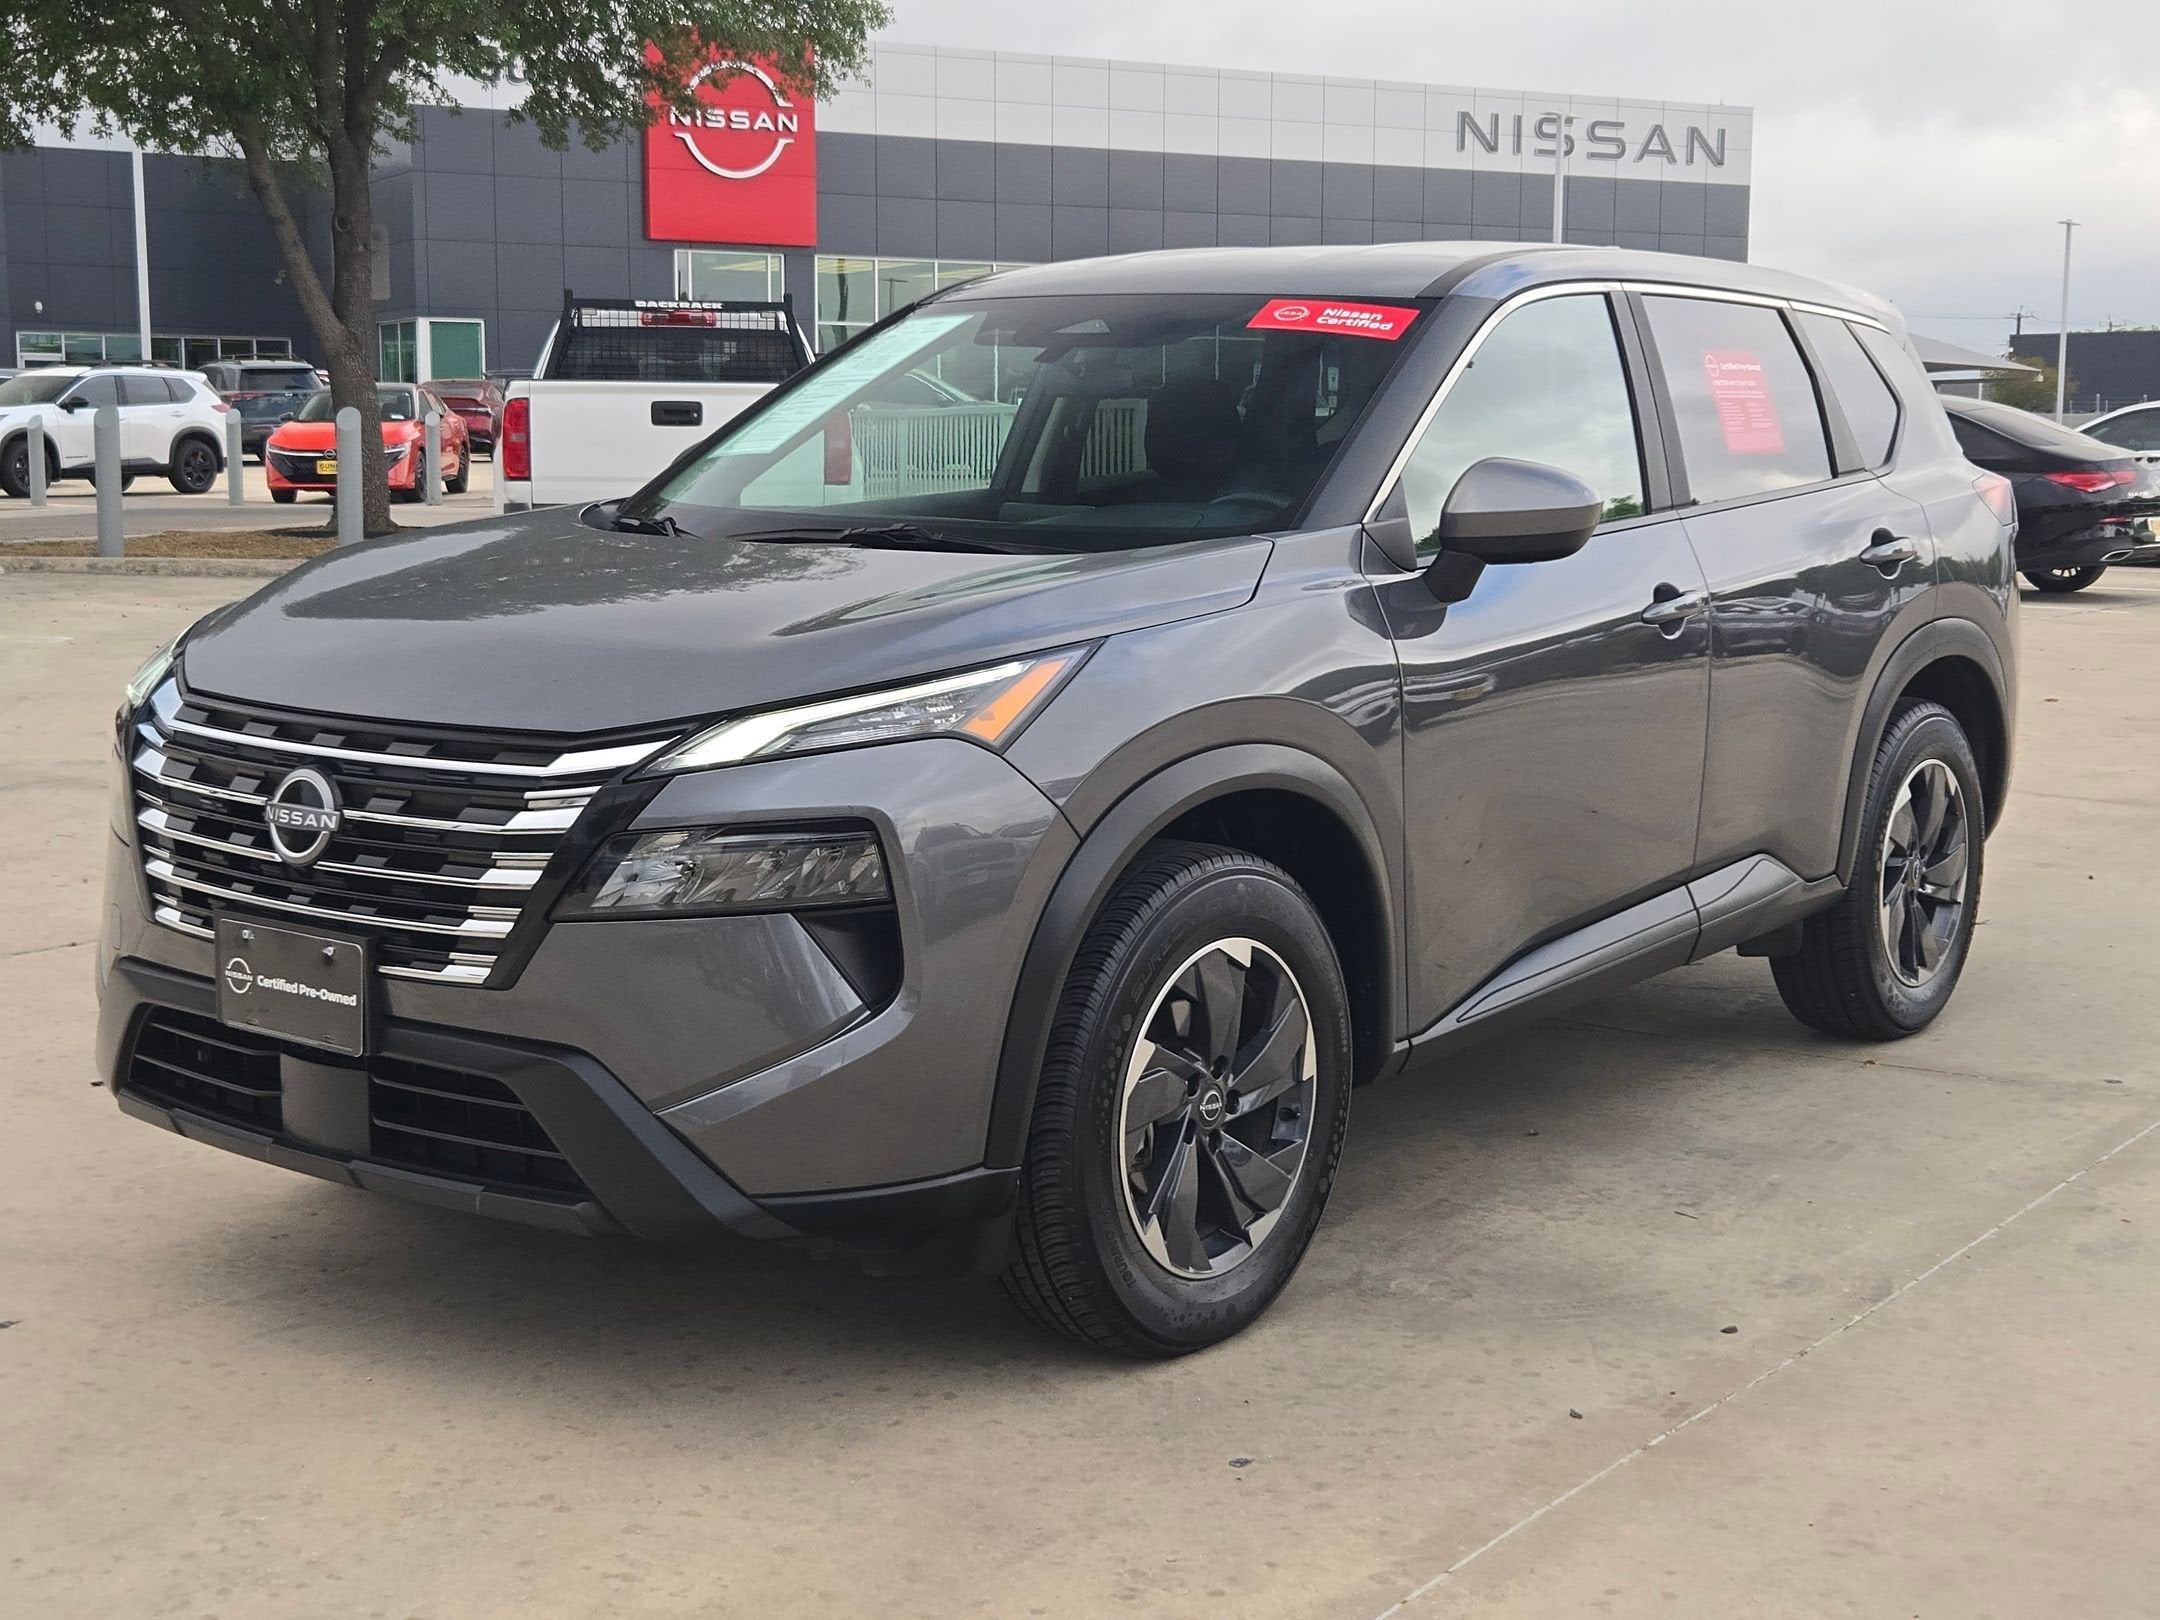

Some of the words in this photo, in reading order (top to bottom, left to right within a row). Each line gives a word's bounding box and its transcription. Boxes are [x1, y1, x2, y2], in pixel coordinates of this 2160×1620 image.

[670, 107, 798, 132] NISSAN
[1456, 111, 1727, 167] NISSAN
[634, 300, 724, 310] BACKRACK
[1323, 308, 1382, 321] Nissan
[1316, 316, 1393, 331] Certified
[265, 805, 337, 829] NISSAN
[224, 969, 253, 982] NISSAN
[256, 975, 298, 994] Certified
[298, 983, 357, 1006] Pre-Owned
